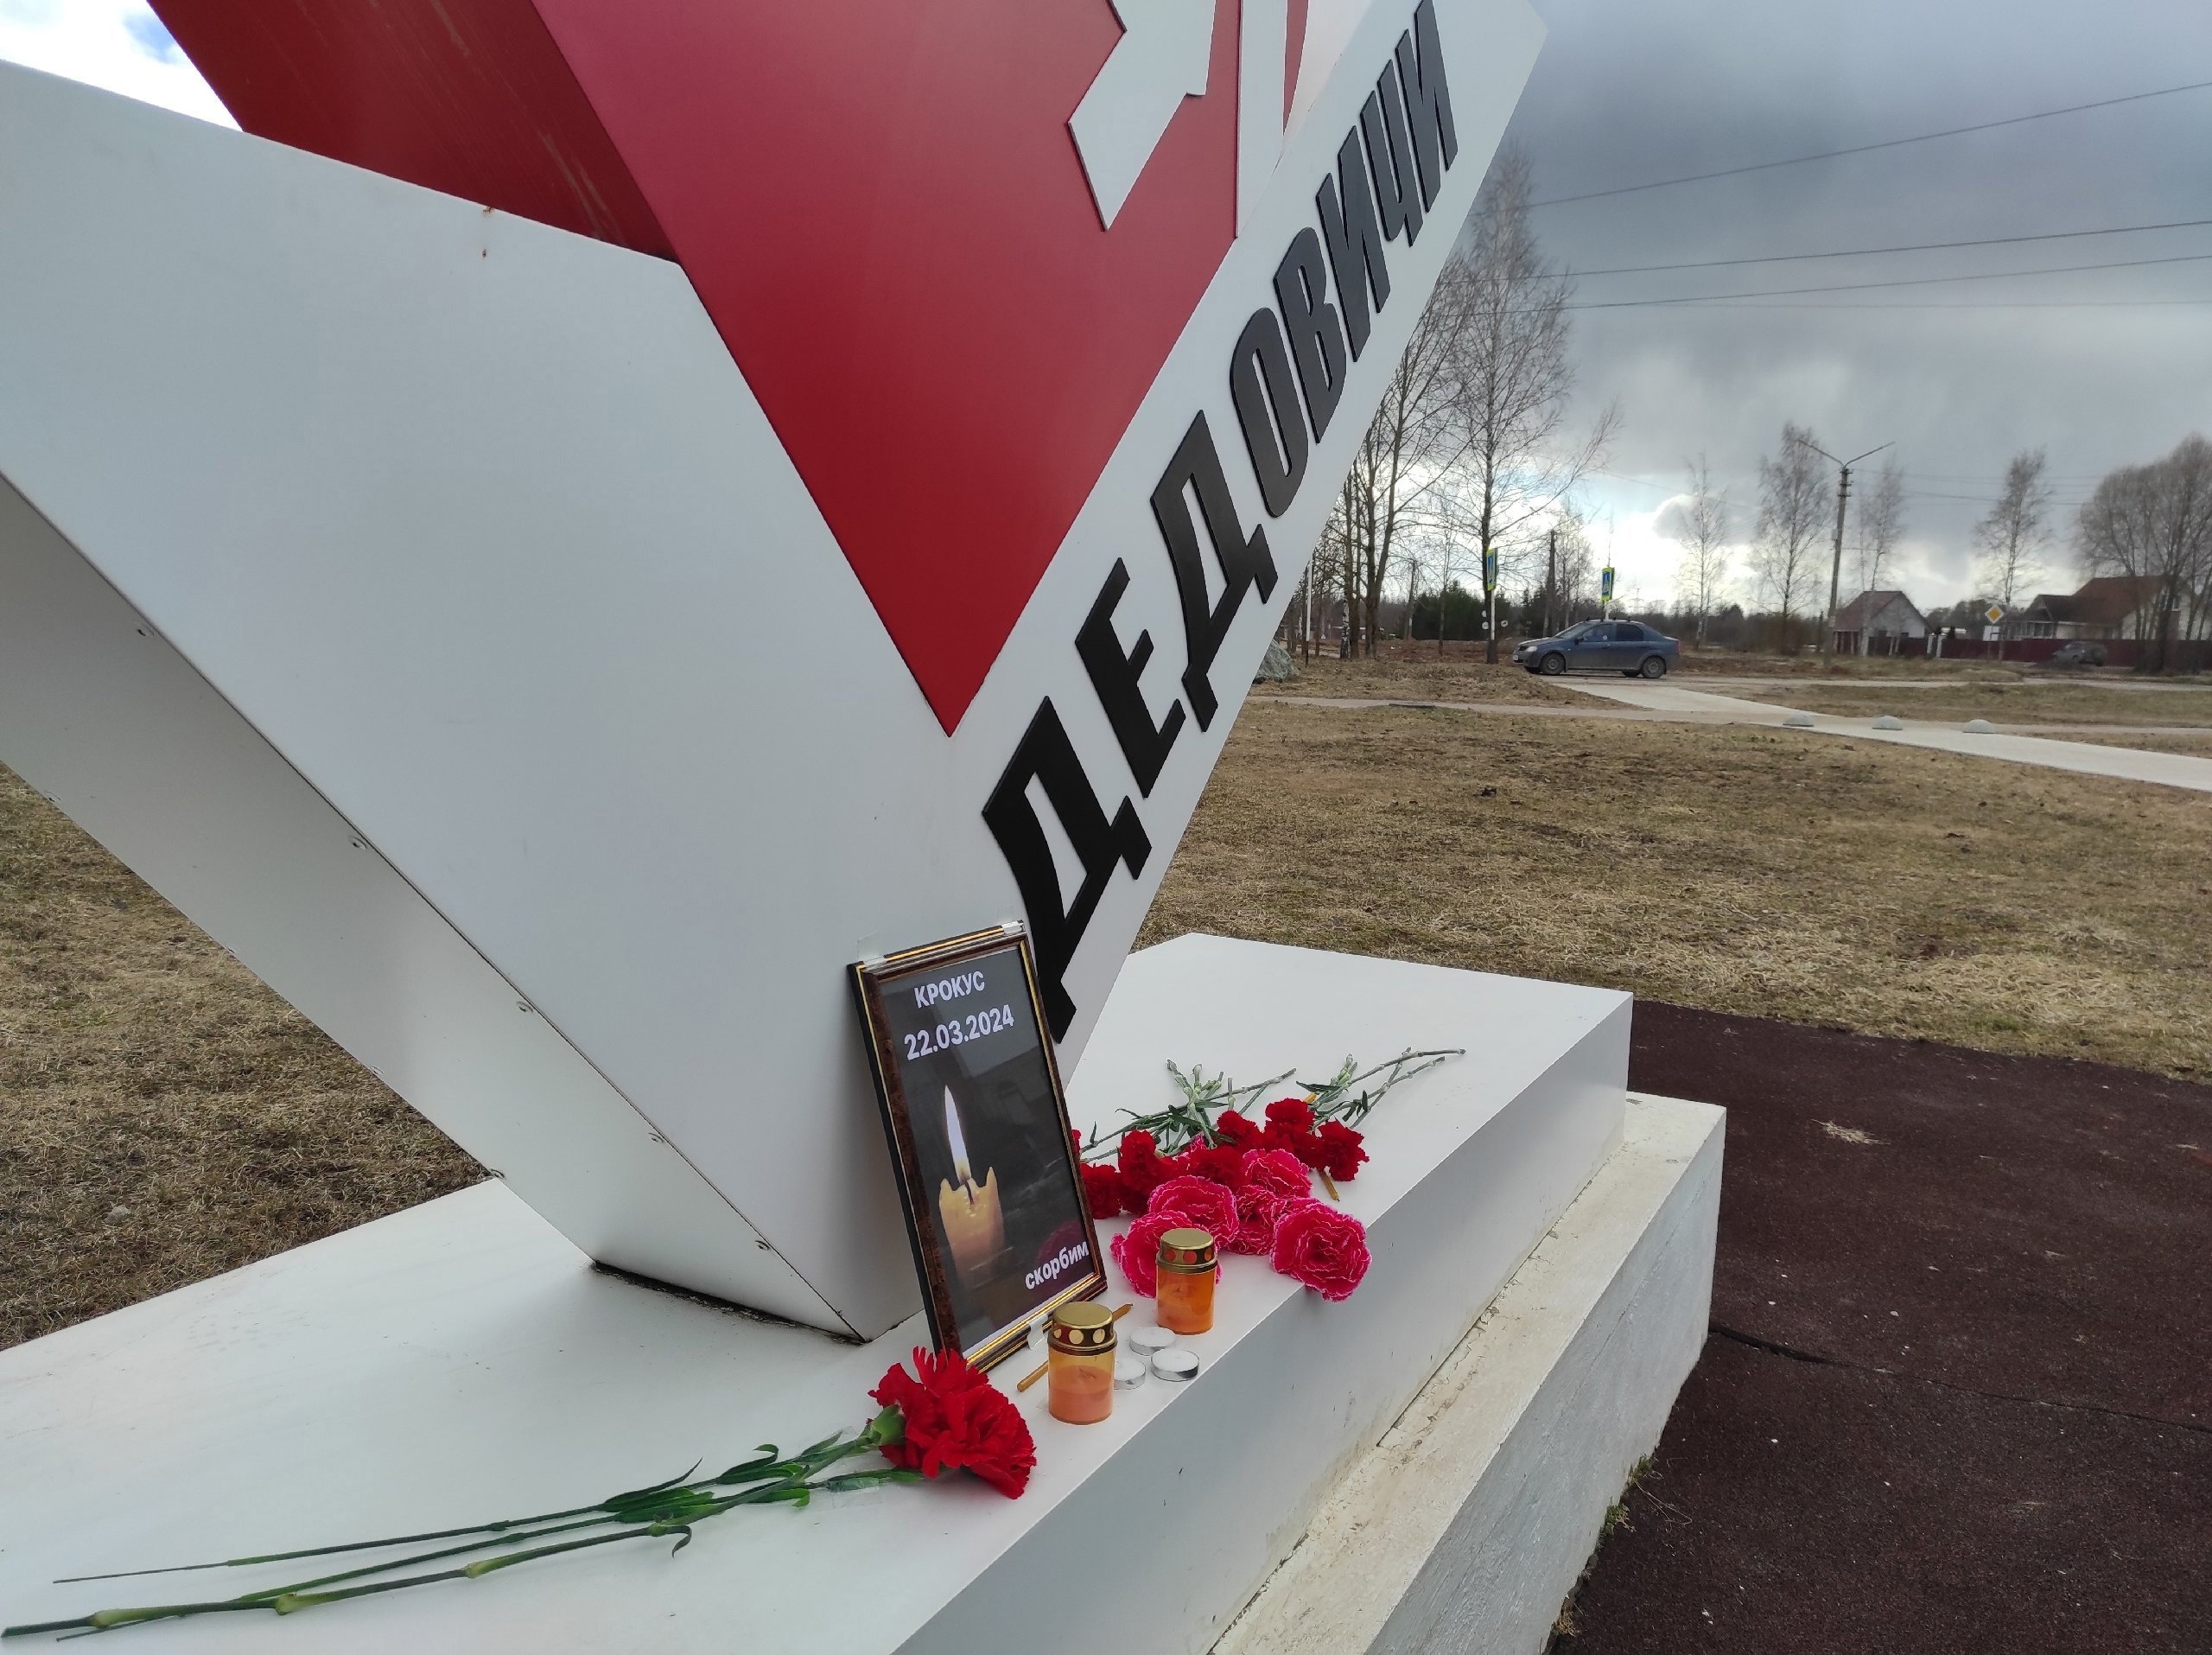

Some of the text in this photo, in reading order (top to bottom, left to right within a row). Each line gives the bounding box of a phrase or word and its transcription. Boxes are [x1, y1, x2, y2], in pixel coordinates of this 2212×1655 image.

[982, 0, 1459, 1044] ДЕДОВИЧИ
[914, 971, 985, 1009] КРОКУС
[904, 1004, 1014, 1060] 22.03.2024
[1025, 1241, 1090, 1289] скорбим
